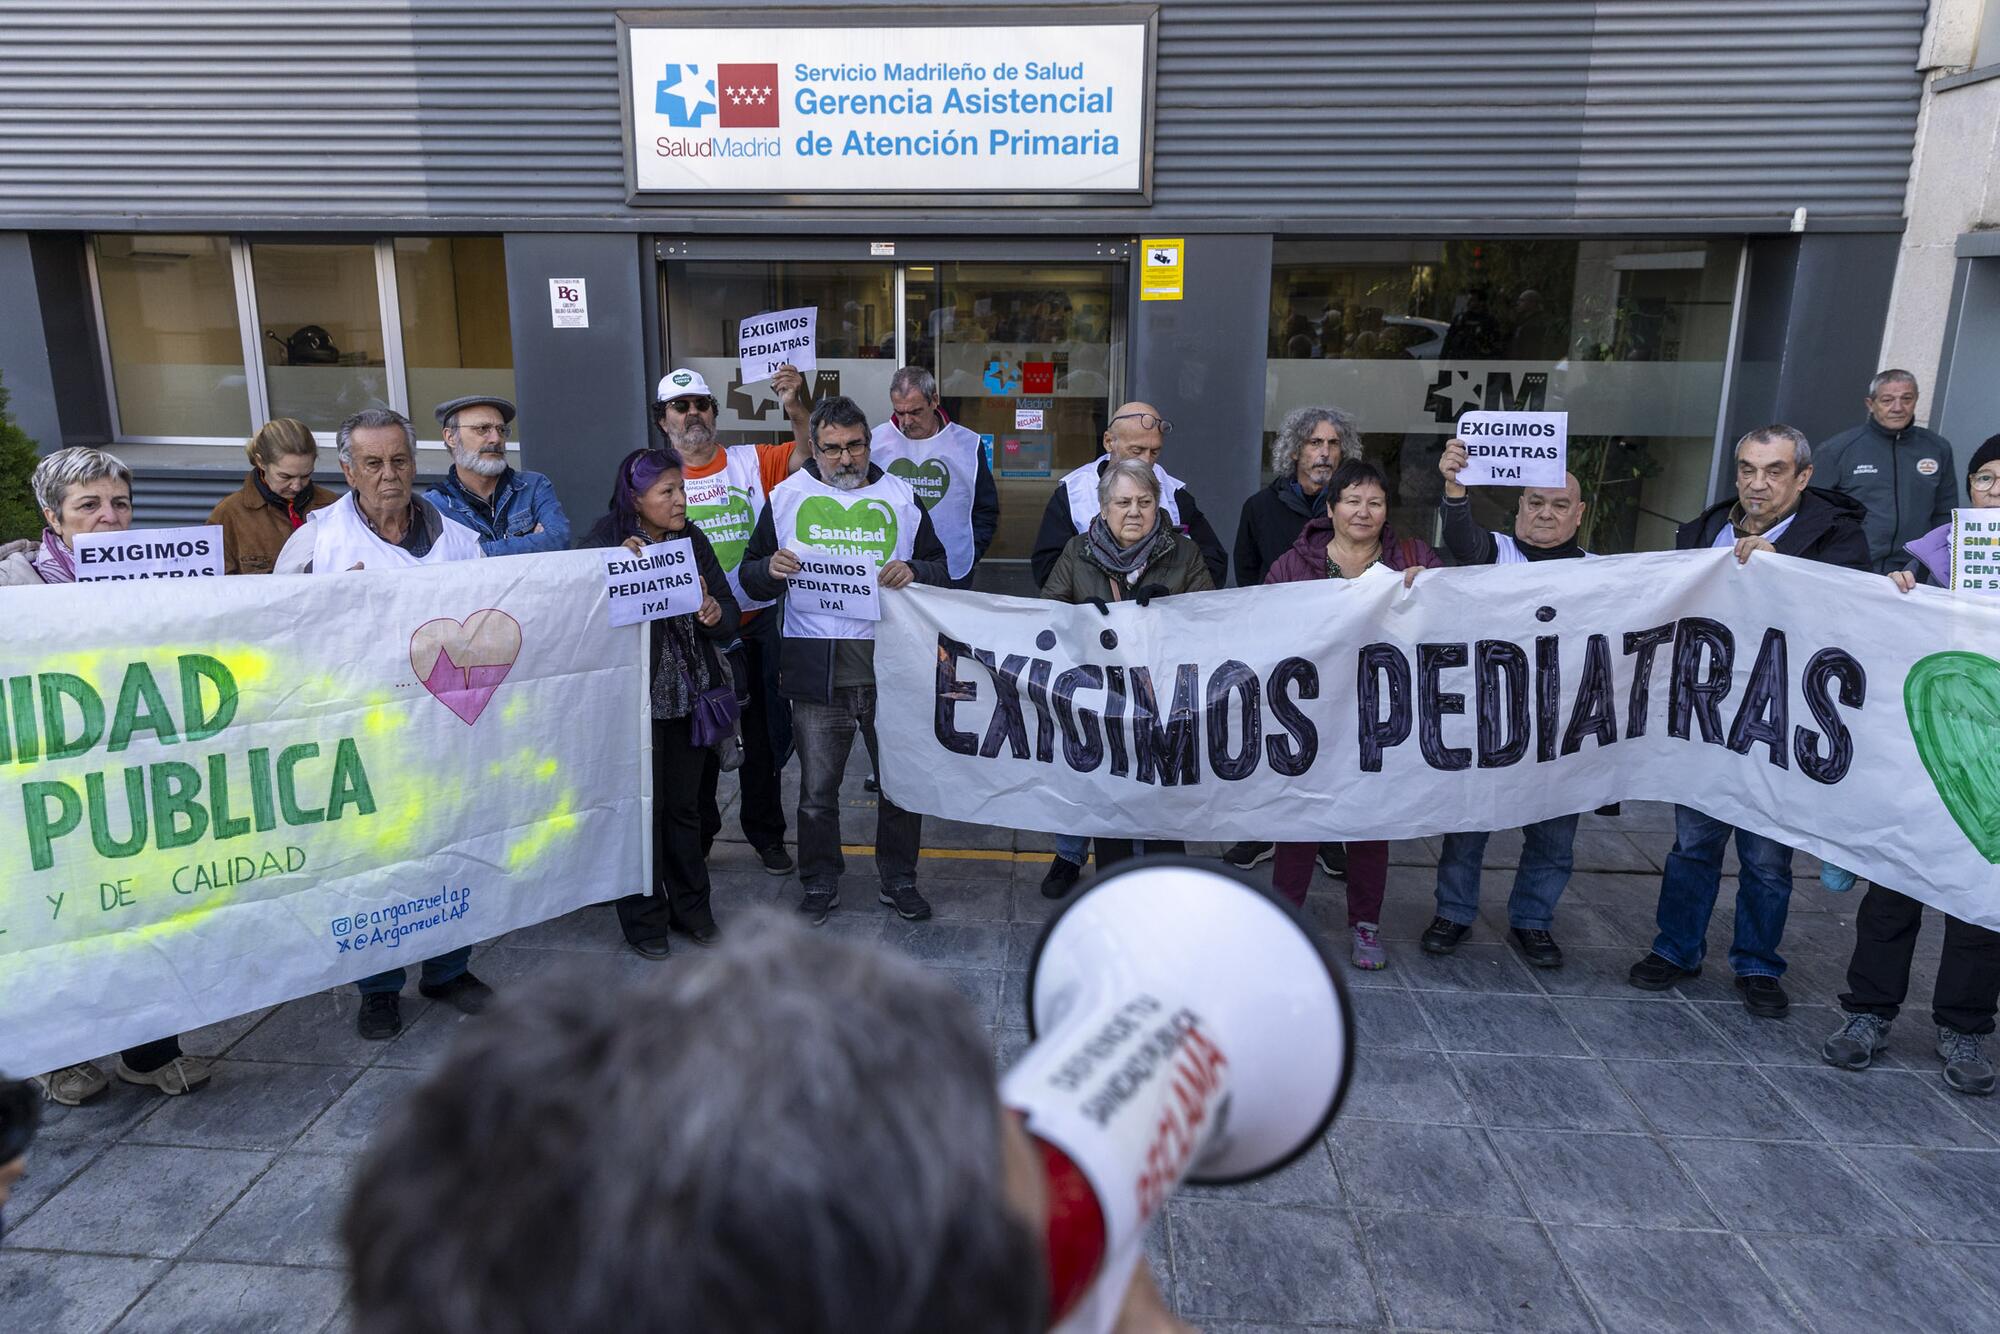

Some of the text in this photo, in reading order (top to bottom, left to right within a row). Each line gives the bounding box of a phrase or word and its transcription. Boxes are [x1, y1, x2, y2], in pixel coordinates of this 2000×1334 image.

[795, 61, 1083, 81] Servicio Madrileño de Salud
[795, 86, 1113, 114] Gerencia Asistencial
[656, 136, 781, 158] SaludMadrid
[796, 129, 1119, 156] de Atención Primaria
[558, 286, 578, 302] BG
[742, 317, 808, 339] EXIGIMOS
[740, 335, 810, 358] PEDIATRAS
[1460, 422, 1556, 437] EXIGIMOS
[1466, 445, 1558, 459] EDIATRAS
[897, 476, 943, 487] anidad
[1491, 466, 1521, 479] ¡YA!
[688, 487, 727, 505] RECLAMA
[912, 487, 941, 498] blica
[691, 510, 750, 529] anidad
[1964, 522, 2000, 532] NI U
[808, 524, 886, 542] Sanidad
[1963, 537, 1991, 546] SIN
[80, 540, 210, 564] EXIGIMOS
[1964, 551, 1986, 560] EN
[607, 551, 685, 576] EXIGIMOS
[796, 561, 867, 577] XIGIMOS
[608, 572, 693, 598] PEDIATRAS
[788, 578, 871, 596] PEDIATRAS
[1963, 579, 1983, 589] DE
[642, 598, 669, 615] ¡YA!
[819, 598, 844, 611] ¡YA!
[1357, 605, 1867, 785] PEDIATRAS
[22, 737, 377, 872] PUBLICA
[46, 846, 306, 920] Y DE CALIDAD
[354, 885, 470, 927] @arganzuelap
[354, 902, 470, 951] @ArganzuelAP
